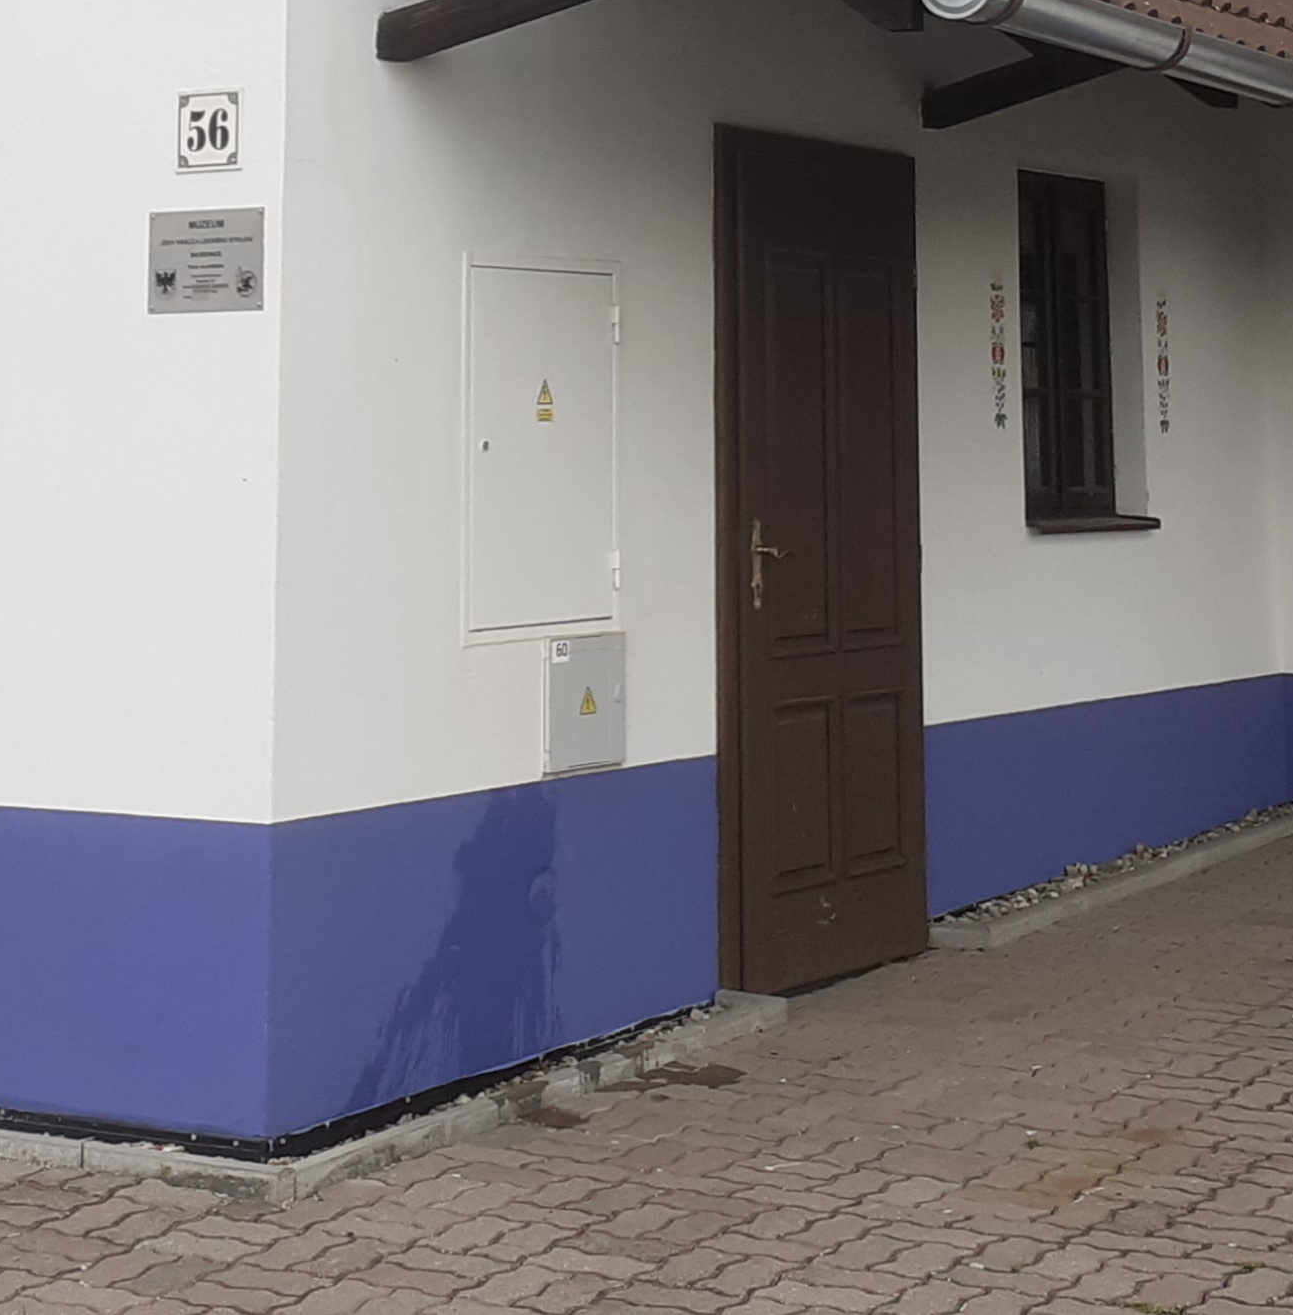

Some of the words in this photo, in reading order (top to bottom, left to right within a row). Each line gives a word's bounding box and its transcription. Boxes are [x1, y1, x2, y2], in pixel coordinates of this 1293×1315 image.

[186, 107, 230, 152] 56
[188, 219, 225, 229] MUZEUM
[556, 642, 568, 657] 60
